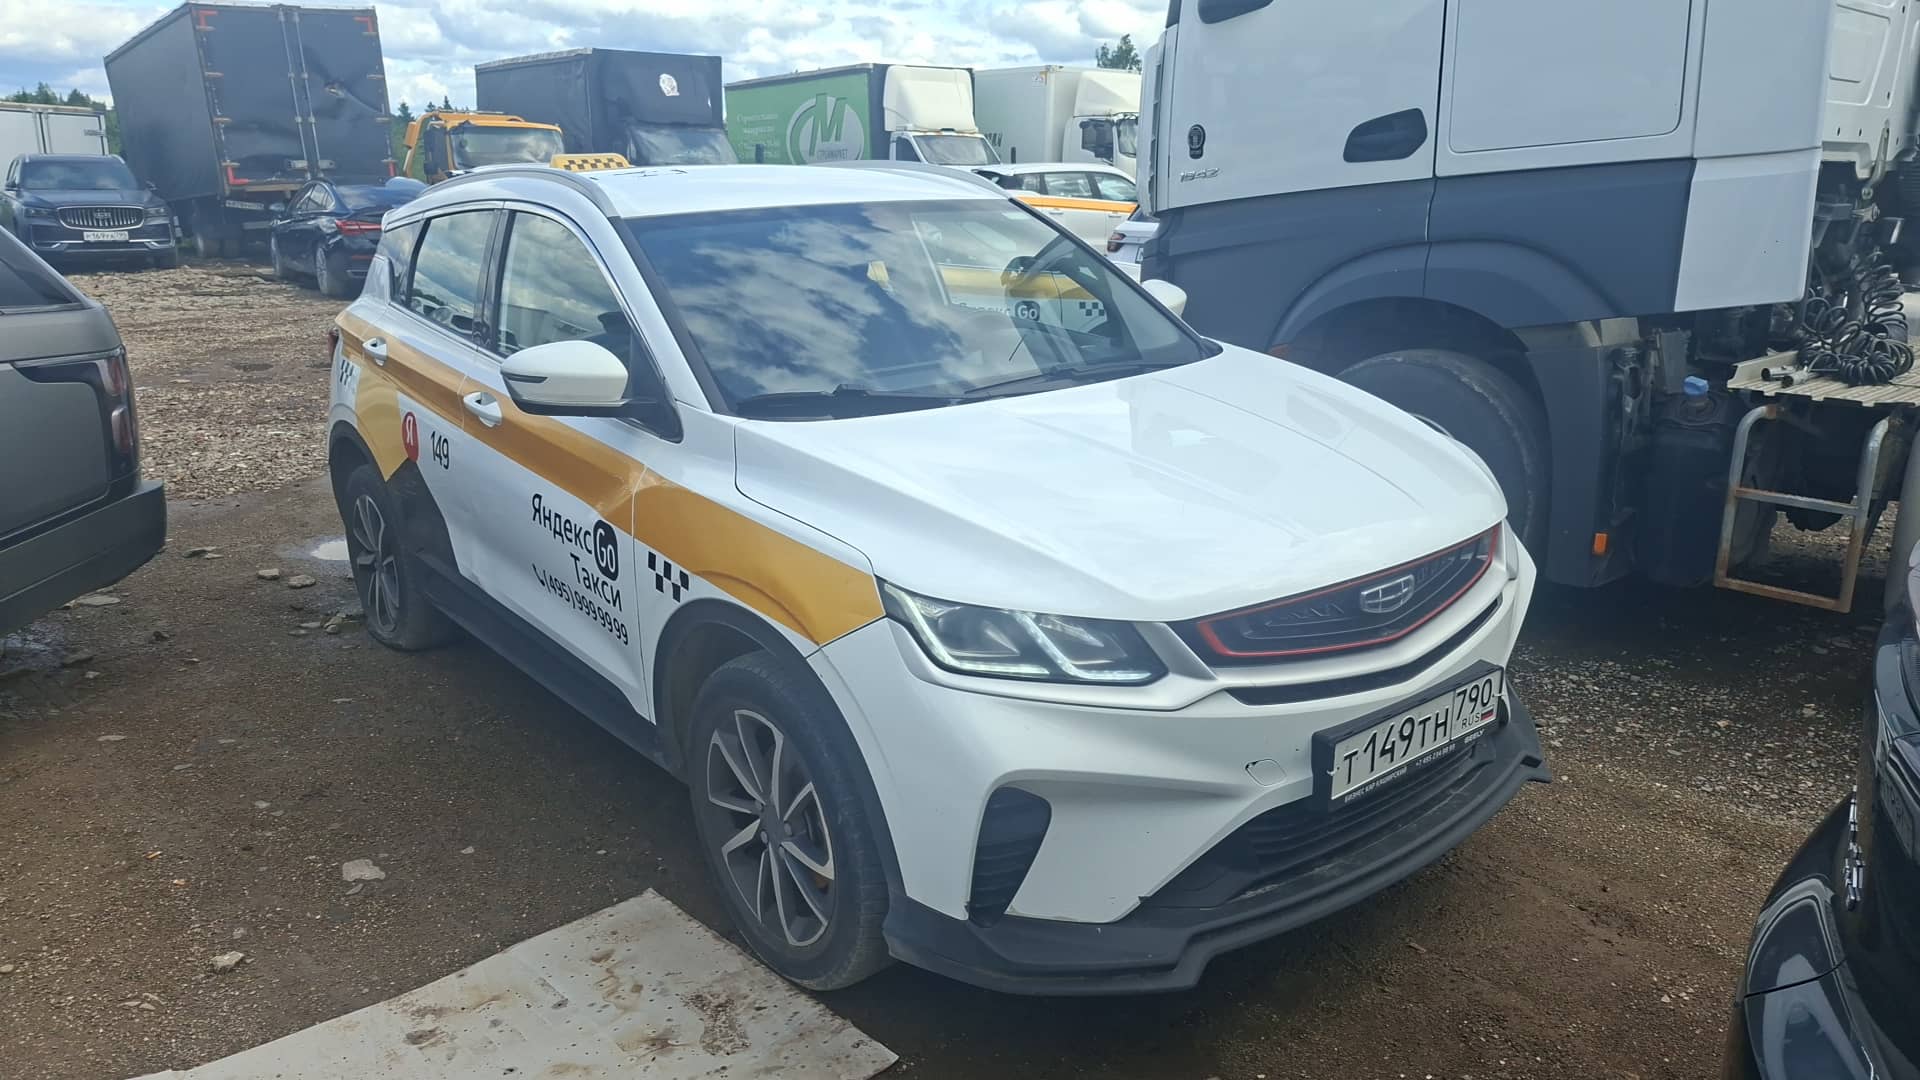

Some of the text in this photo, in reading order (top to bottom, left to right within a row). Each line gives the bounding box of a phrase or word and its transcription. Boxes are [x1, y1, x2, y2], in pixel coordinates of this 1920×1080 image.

[1017, 305, 1038, 320] Go
[431, 430, 450, 470] 149
[532, 493, 617, 574] Яндекс Go
[570, 552, 623, 612] Такси
[1456, 678, 1493, 721] 790
[1462, 712, 1480, 729] RUS
